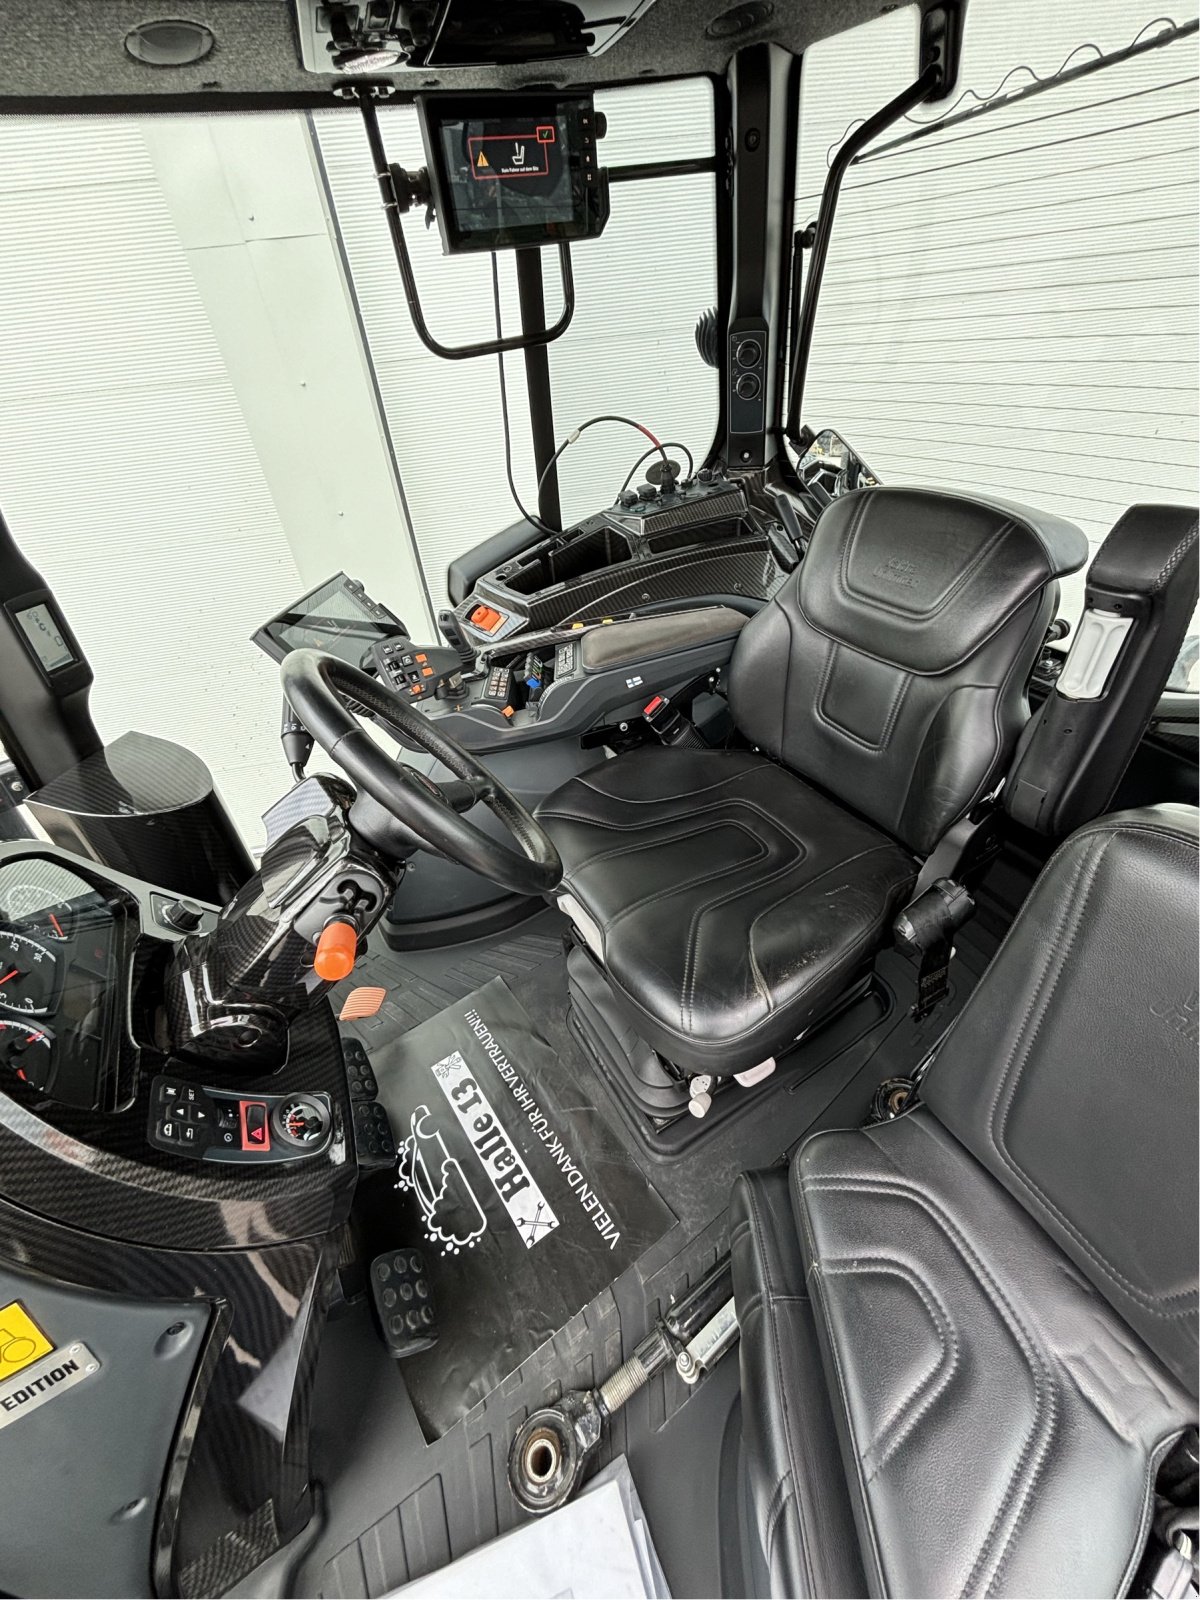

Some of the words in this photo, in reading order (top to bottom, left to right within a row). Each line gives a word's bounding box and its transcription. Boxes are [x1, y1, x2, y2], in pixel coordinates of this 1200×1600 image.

[464, 1009, 520, 1088] VERTRAUEN!!!
[451, 1077, 483, 1114] 13
[512, 1084, 535, 1111] IHR
[528, 1107, 554, 1141] FÜR
[472, 1112, 531, 1203] Halle
[545, 1136, 583, 1187] DANK
[575, 1183, 621, 1250] VIELEN
[0, 1359, 80, 1411] EDITION
